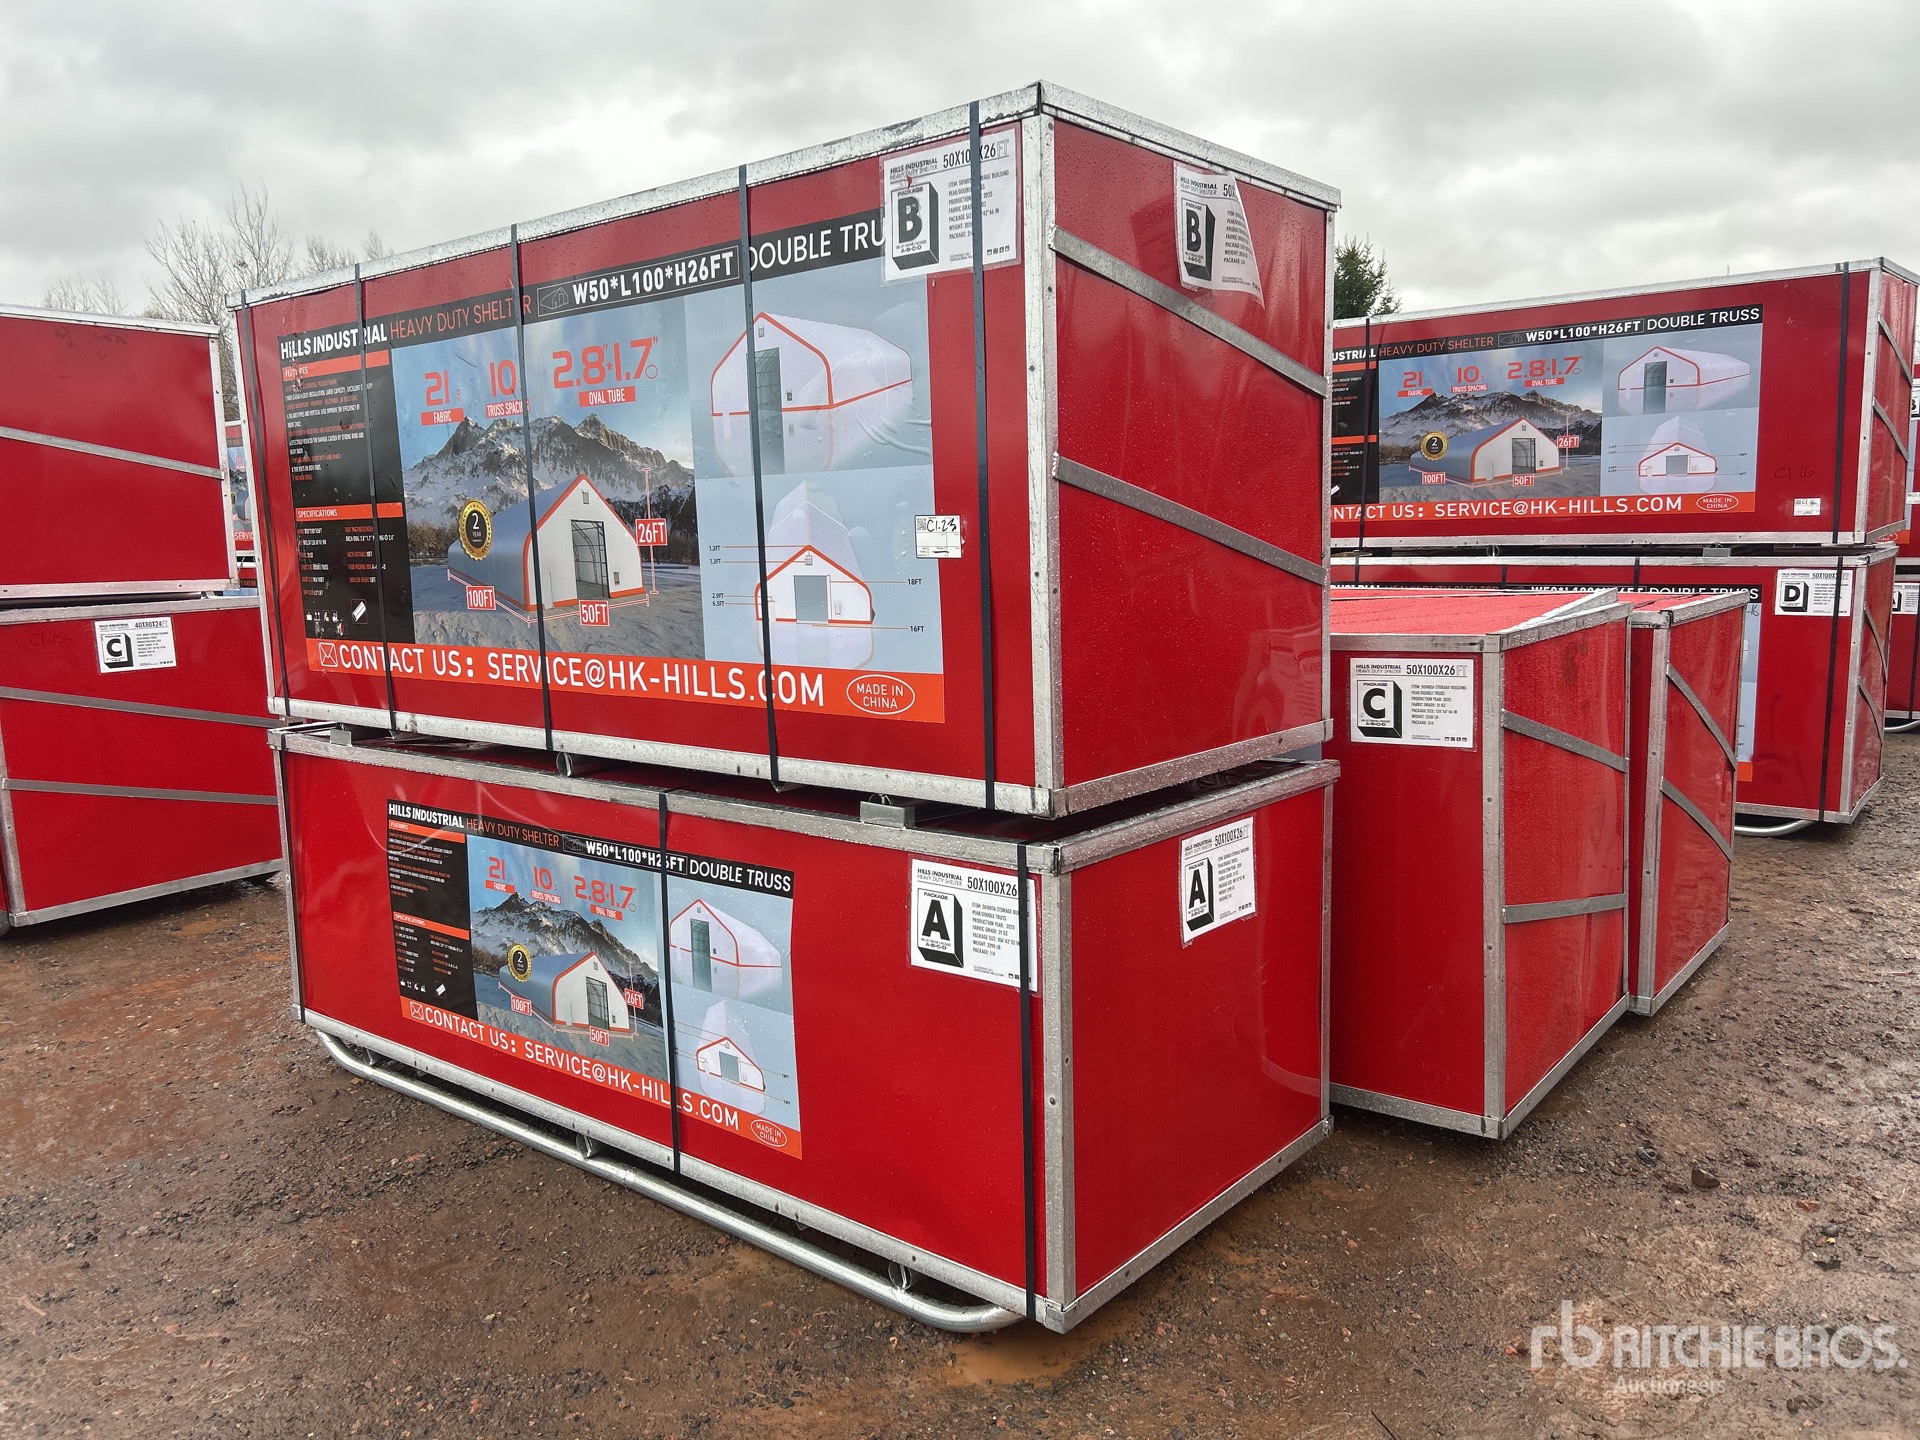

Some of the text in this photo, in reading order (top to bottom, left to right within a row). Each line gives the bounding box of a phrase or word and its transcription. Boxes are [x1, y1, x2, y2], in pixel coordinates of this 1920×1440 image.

[890, 166, 904, 174] HILLS
[906, 158, 938, 170] INDUSTRIAL
[898, 186, 924, 197] PACKAGE
[898, 196, 922, 244] B
[1186, 209, 1201, 252] B
[280, 338, 311, 360] HILLS
[390, 317, 433, 340] HEAVY
[437, 307, 470, 332] DUTY
[474, 295, 532, 324] SHELTR
[750, 229, 832, 272] DOUBLE
[840, 219, 886, 253] TRU
[1380, 345, 1414, 356] HEAVY
[1417, 341, 1445, 352] DUTY
[1448, 336, 1494, 350] SHELTER
[1647, 313, 1705, 331] DOUBLE
[1710, 308, 1760, 324] TRUSS
[490, 360, 517, 398] 10
[1404, 370, 1422, 388] 21
[1458, 366, 1480, 384] 10
[424, 370, 450, 406] 21
[588, 388, 626, 406] OVAL TUBE
[486, 403, 504, 418] TRUSS
[1431, 438, 1438, 446] 2
[1558, 437, 1578, 447] 26FT
[1423, 474, 1444, 484] 100FT
[1514, 476, 1532, 486] 50FT
[298, 508, 338, 518] SPECIFICATIONS
[1434, 496, 1682, 518] SERVICE@HK-HILLS.COM
[472, 512, 480, 530] 2
[638, 523, 665, 544] 26FT
[468, 589, 494, 608] 100FT
[1784, 585, 1800, 602] D
[582, 604, 608, 624] 50FT
[106, 638, 122, 657] C
[340, 644, 424, 674] CONTACT
[488, 652, 824, 706] SERVICE@HK-HILLS.COM
[856, 683, 904, 696] MADE IN
[863, 696, 898, 709] CHINA
[1363, 688, 1386, 719] C
[388, 804, 412, 818] HILLS
[412, 808, 464, 828] INDUSTRIAL
[466, 818, 496, 834] HEAVY
[498, 824, 521, 840] DUTY
[522, 828, 560, 848] SHELTER
[690, 859, 742, 884] DOUBLE
[747, 869, 791, 892] TRUSS
[488, 856, 505, 880] 21
[918, 868, 930, 876] HILLS
[932, 870, 962, 881] INDUSTRIAL
[534, 866, 552, 890] 10
[924, 892, 948, 900] PACKAGE
[1189, 869, 1206, 909] A
[922, 900, 950, 941] A
[972, 918, 994, 926] PRODUCTION
[512, 998, 530, 1014] 100FT
[626, 991, 644, 1008] 26FT
[425, 1008, 484, 1042] CONTACT
[591, 1028, 608, 1045] 50FT
[756, 1123, 782, 1138] MADE IN
[760, 1132, 779, 1144] CHINA
